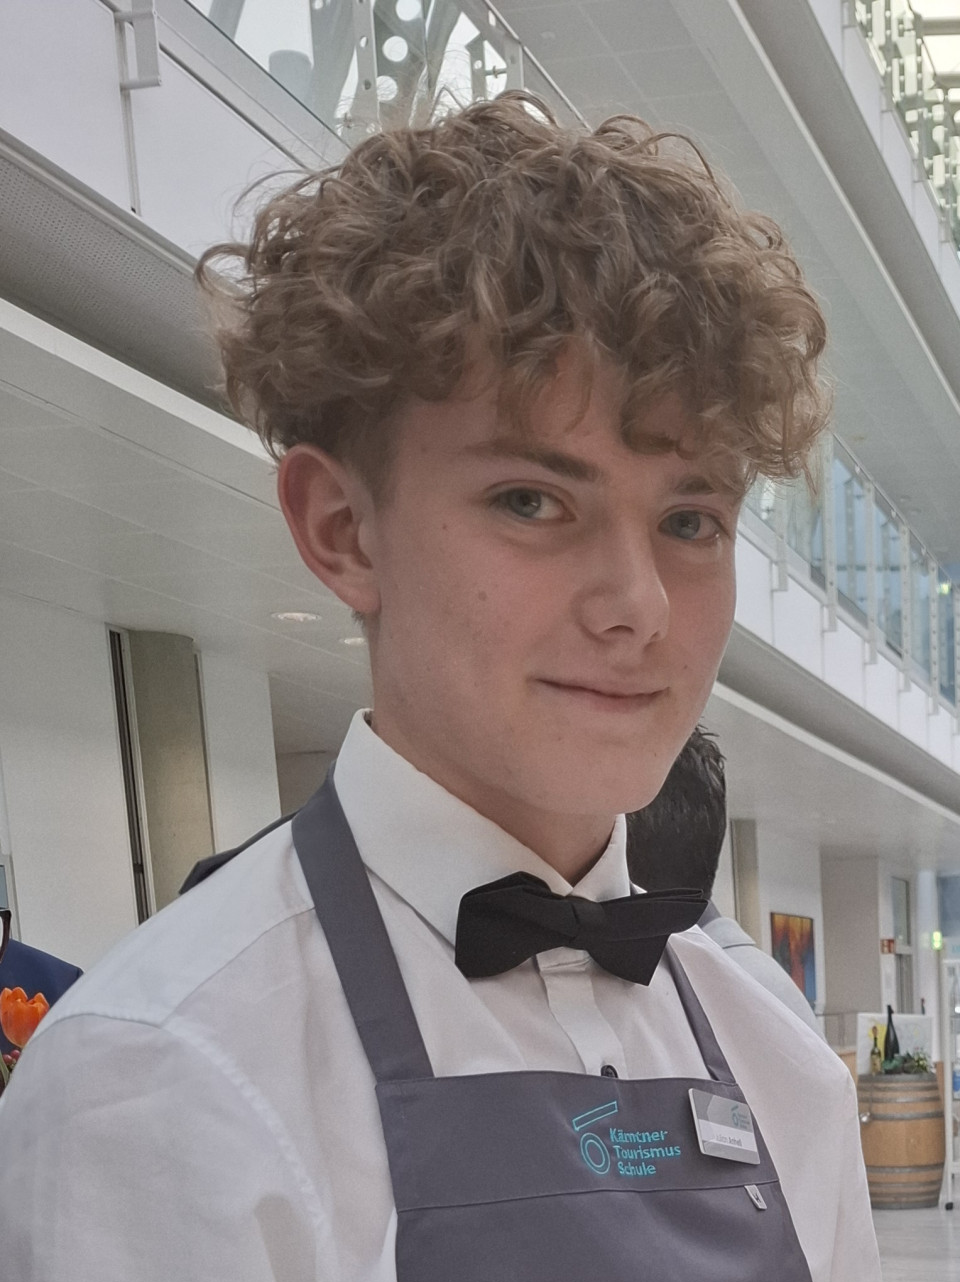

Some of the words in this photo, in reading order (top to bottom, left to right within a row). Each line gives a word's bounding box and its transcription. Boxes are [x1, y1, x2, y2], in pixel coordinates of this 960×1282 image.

[610, 1128, 667, 1143] Kärntner
[614, 1145, 681, 1160] Tourismus
[618, 1162, 656, 1176] Schule
